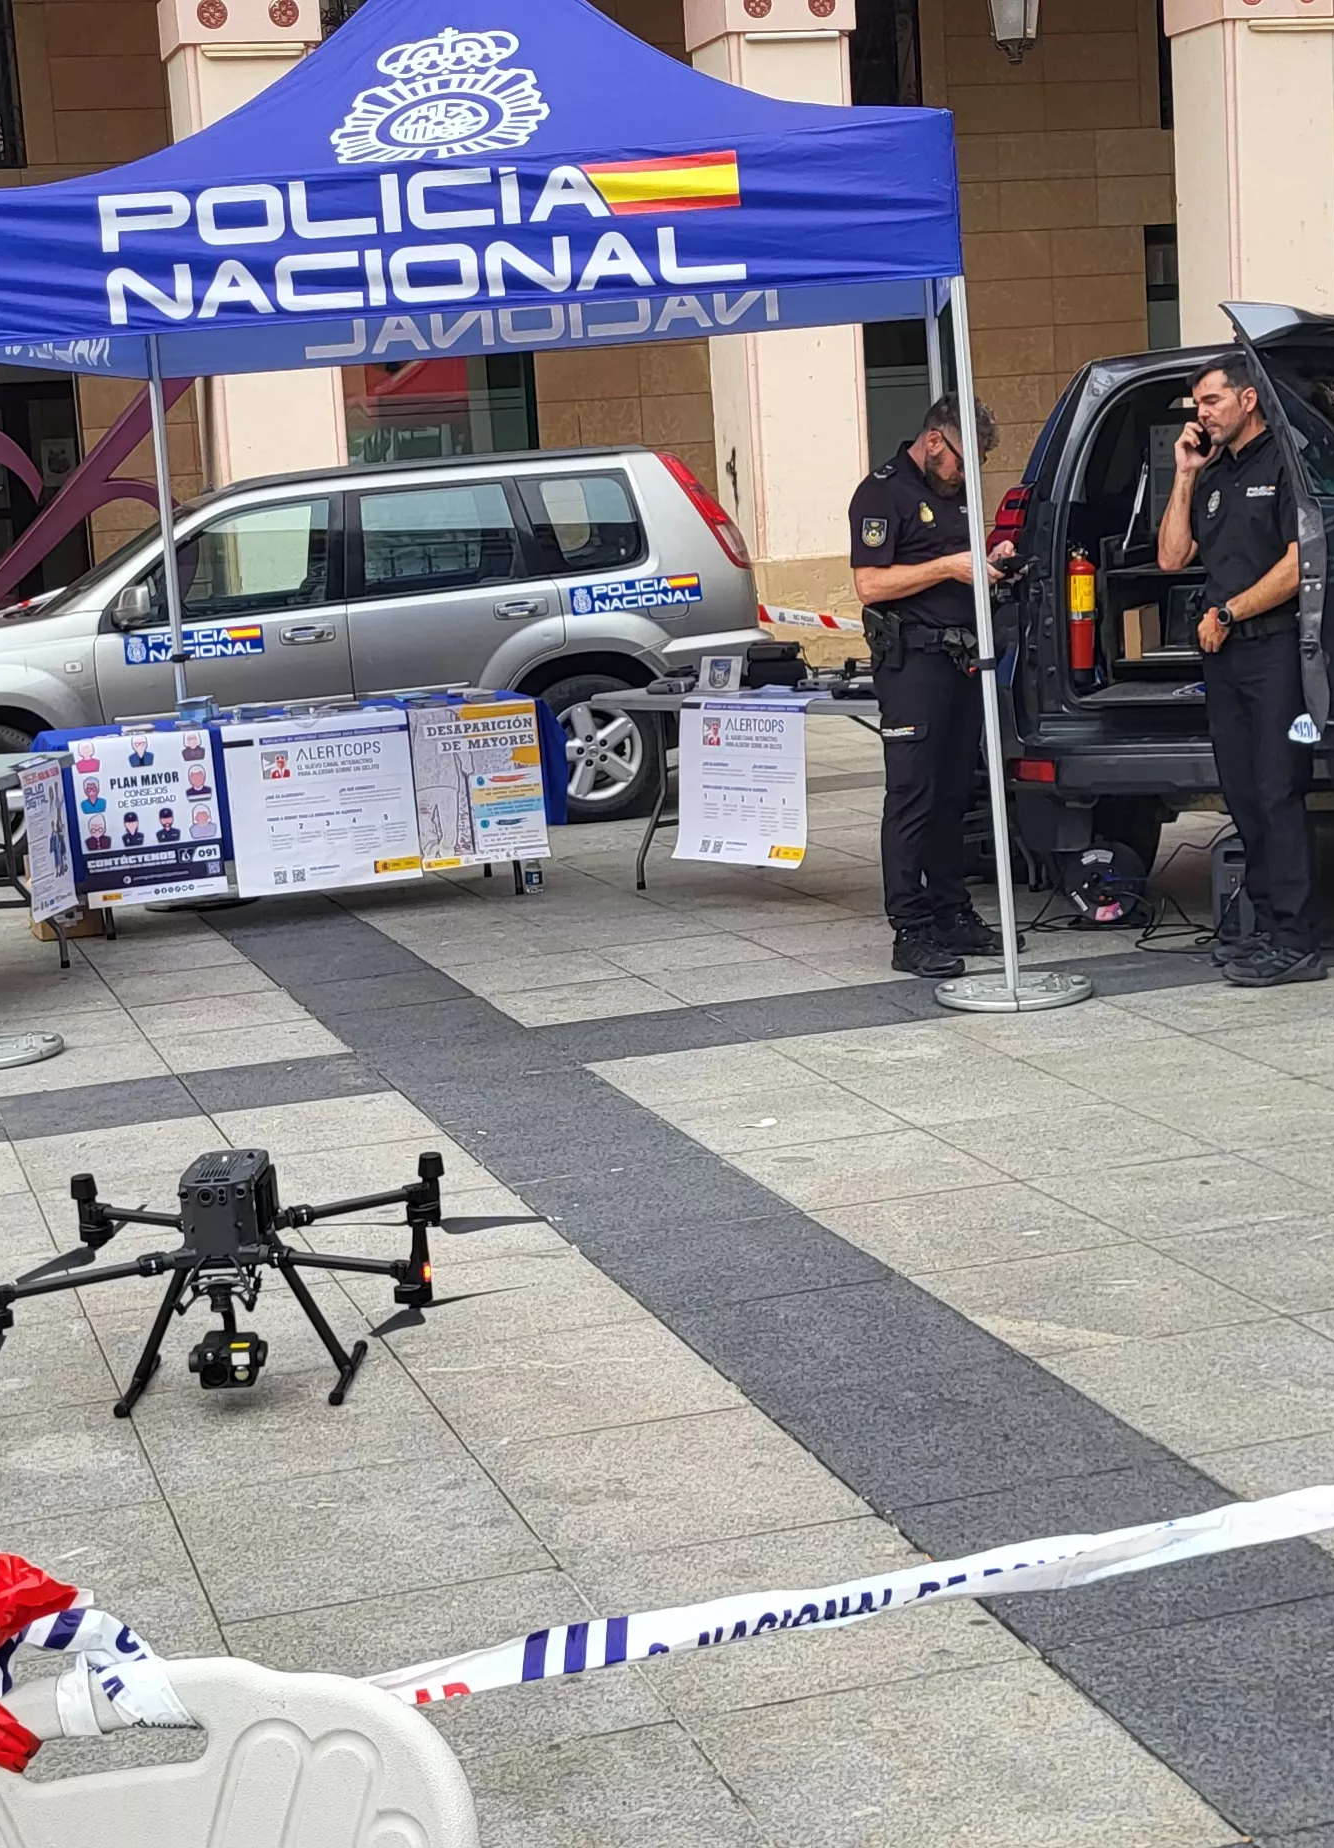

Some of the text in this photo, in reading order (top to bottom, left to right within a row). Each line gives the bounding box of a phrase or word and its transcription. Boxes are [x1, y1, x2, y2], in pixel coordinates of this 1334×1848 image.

[105, 225, 747, 326] NACIONAL
[594, 589, 701, 613] NACIONAL
[426, 716, 533, 737] DESAPARICIÓN
[295, 740, 382, 762] ALERTCOPS
[441, 734, 535, 752] DE MAYORES
[110, 770, 180, 790] PLAN MAYOR
[118, 794, 177, 809] DE SEGURIDAD
[124, 786, 169, 799] CONSEJOS
[87, 849, 176, 869] CONTÁCTENOS
[198, 847, 218, 857] 091
